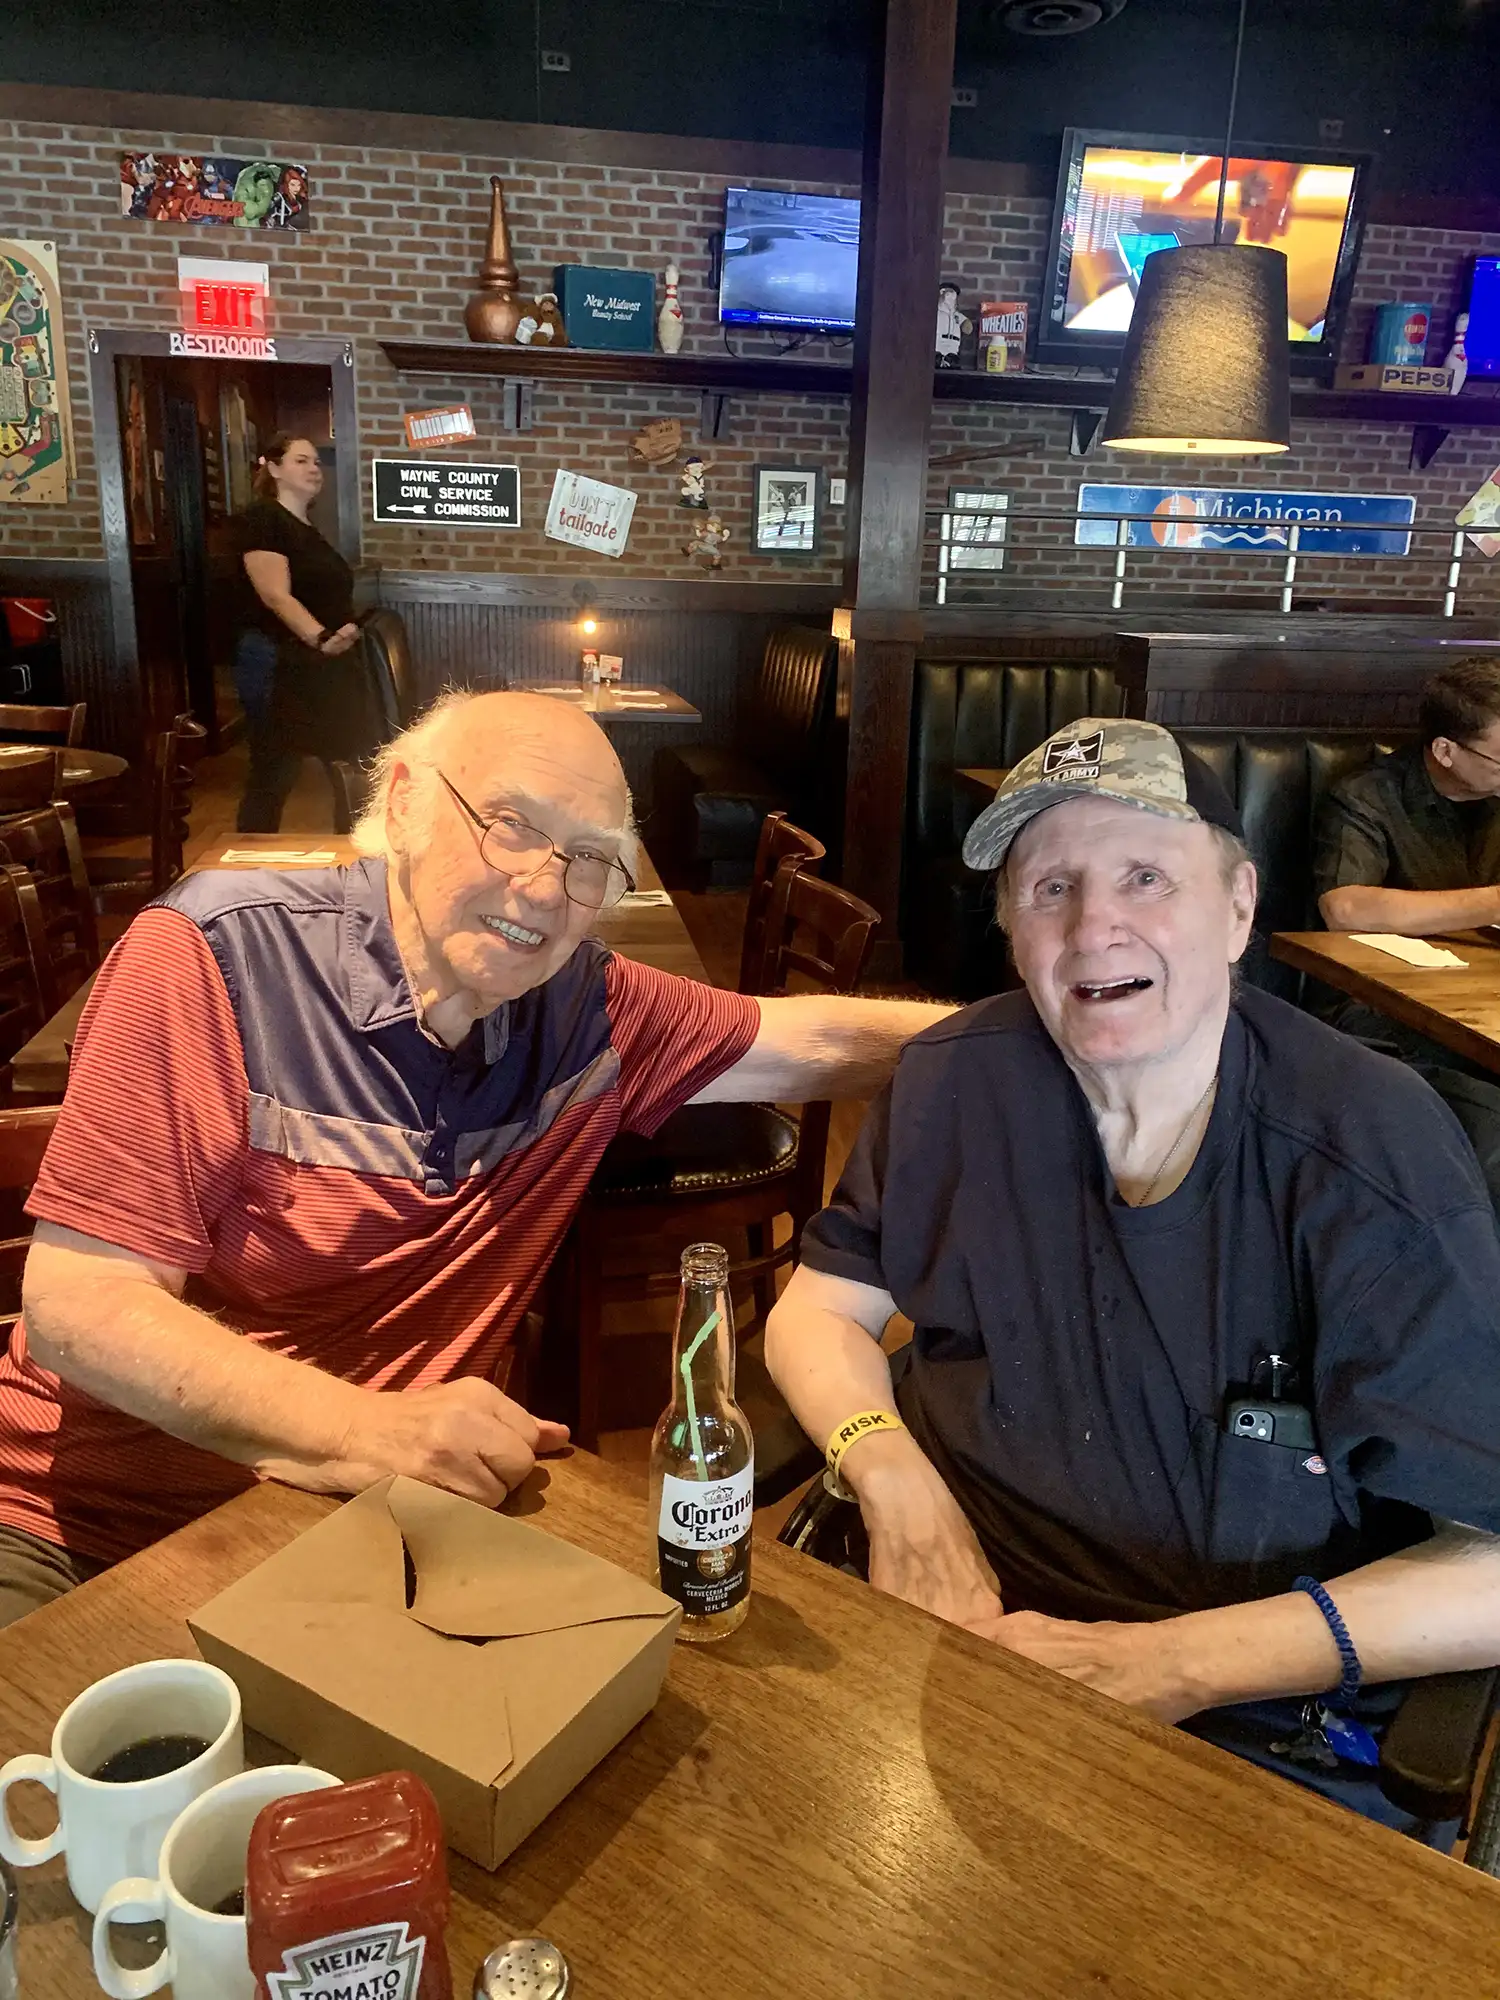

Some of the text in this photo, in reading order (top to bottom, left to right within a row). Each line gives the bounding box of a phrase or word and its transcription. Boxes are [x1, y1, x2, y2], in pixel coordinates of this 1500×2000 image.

[195, 285, 256, 328] EXIT
[584, 294, 641, 311] New Midwest
[592, 308, 633, 321] Beauty School
[982, 311, 1025, 333] WHEATIES
[169, 332, 278, 360] RESTROOMS
[1383, 368, 1454, 389] PEPSI
[400, 469, 500, 485] WAYNE COUNTY
[400, 485, 493, 501] CIVIL SERVICE
[434, 503, 510, 517] COMMISSION
[559, 508, 618, 541] tailgate
[1062, 766, 1095, 780] ARMY
[840, 1414, 889, 1443] RISK
[671, 1489, 752, 1532] Corona
[695, 1524, 740, 1542] Extra
[706, 1592, 728, 1602] MEXICO
[310, 1943, 388, 1976] HEINZ
